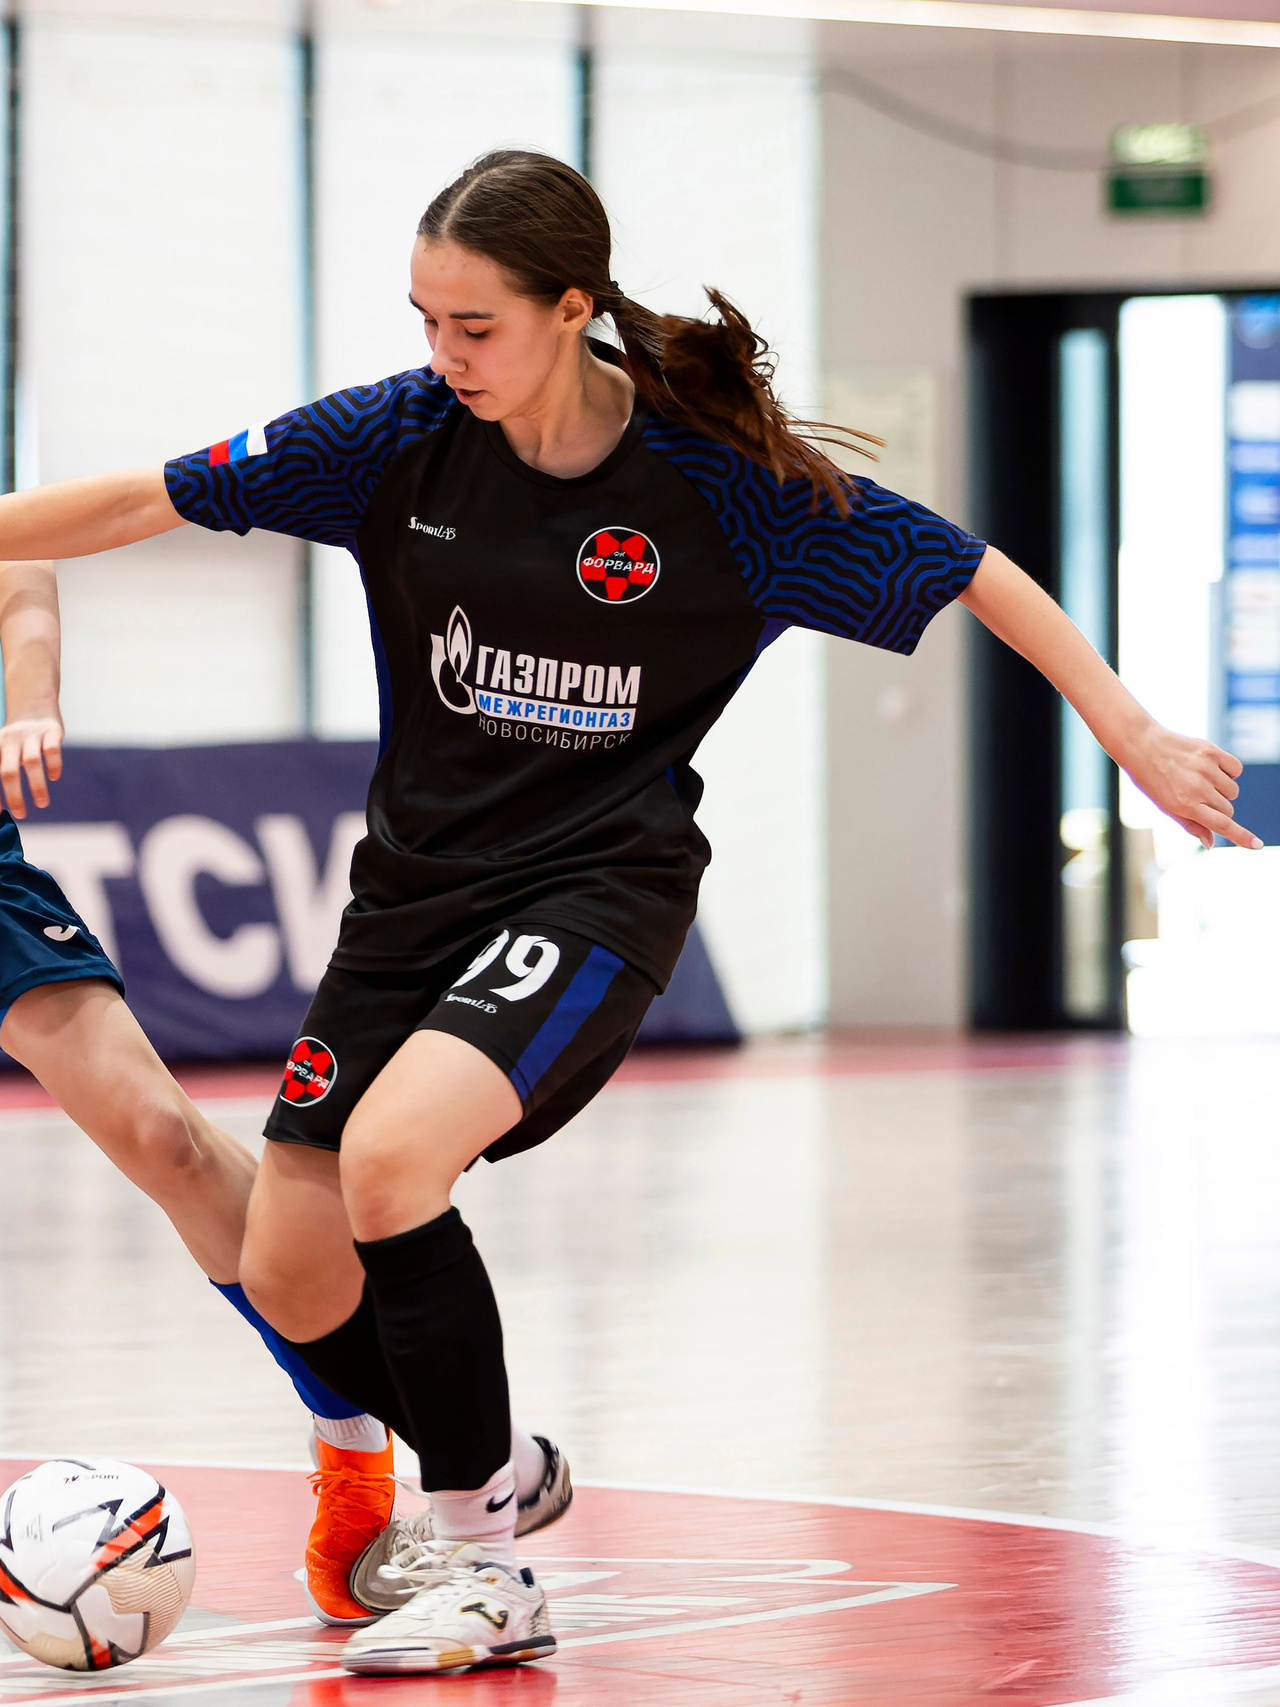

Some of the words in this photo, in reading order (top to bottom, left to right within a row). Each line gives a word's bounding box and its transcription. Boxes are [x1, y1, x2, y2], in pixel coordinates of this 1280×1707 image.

[582, 556, 655, 575] ФОРВАРД
[475, 645, 641, 705] ГАЗПРОМ
[478, 693, 631, 728] МЕЖРЕГИОНГАЗ
[478, 713, 631, 750] НОВОСИБИРСК
[448, 928, 561, 1002] 99
